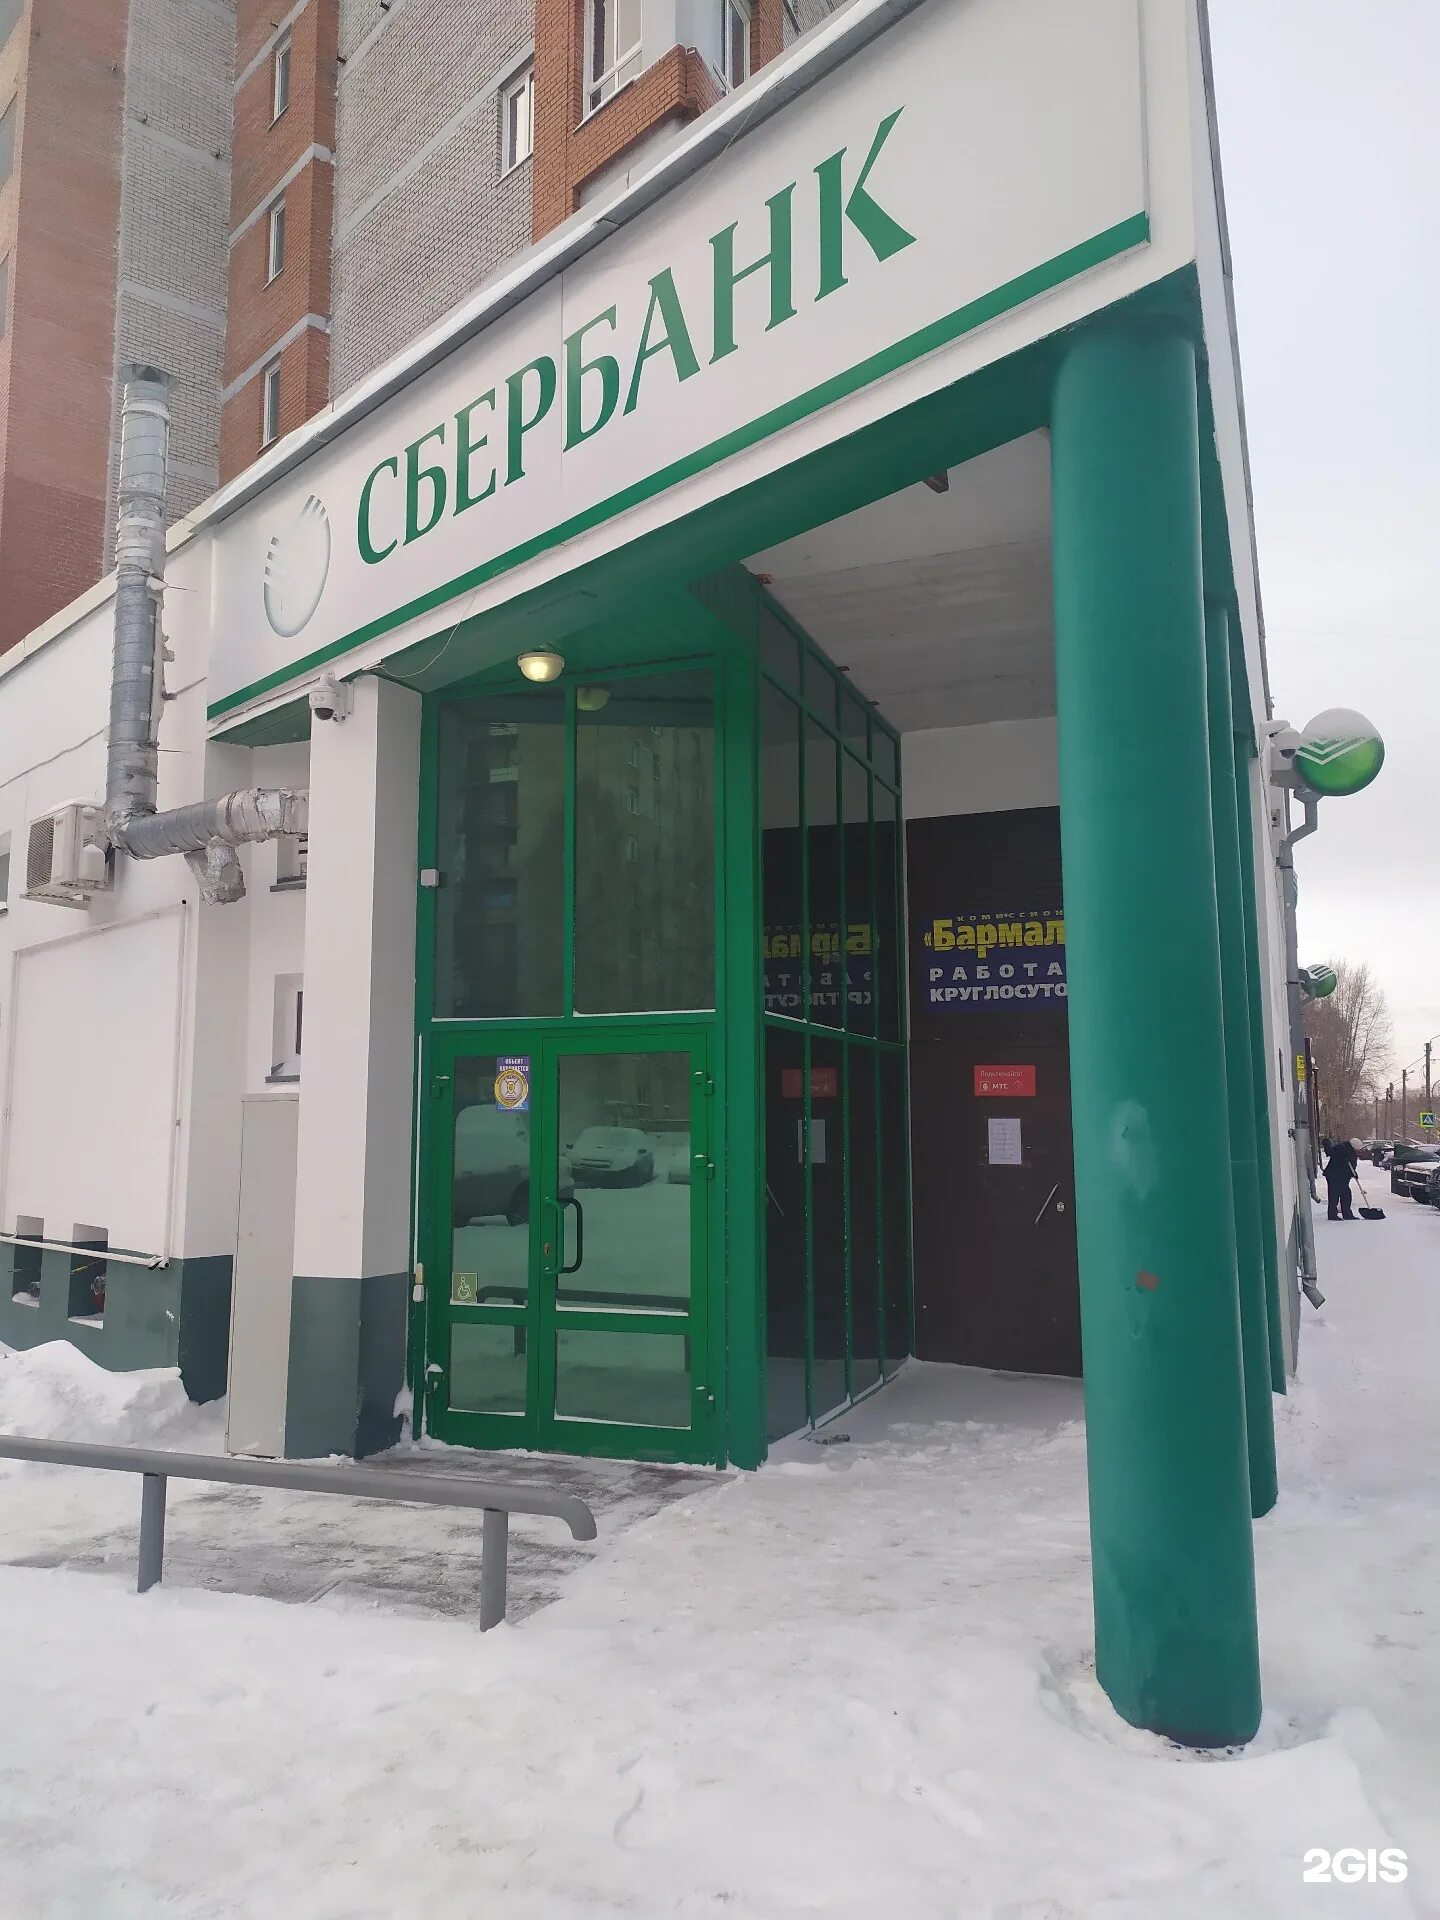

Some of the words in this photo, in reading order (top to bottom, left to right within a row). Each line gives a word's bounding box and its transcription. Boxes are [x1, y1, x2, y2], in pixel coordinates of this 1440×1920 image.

[356, 106, 917, 565] СБЕРБАНК
[929, 962, 1064, 982] РАБОТА
[930, 982, 1068, 1003] КРУГЛОСУТО
